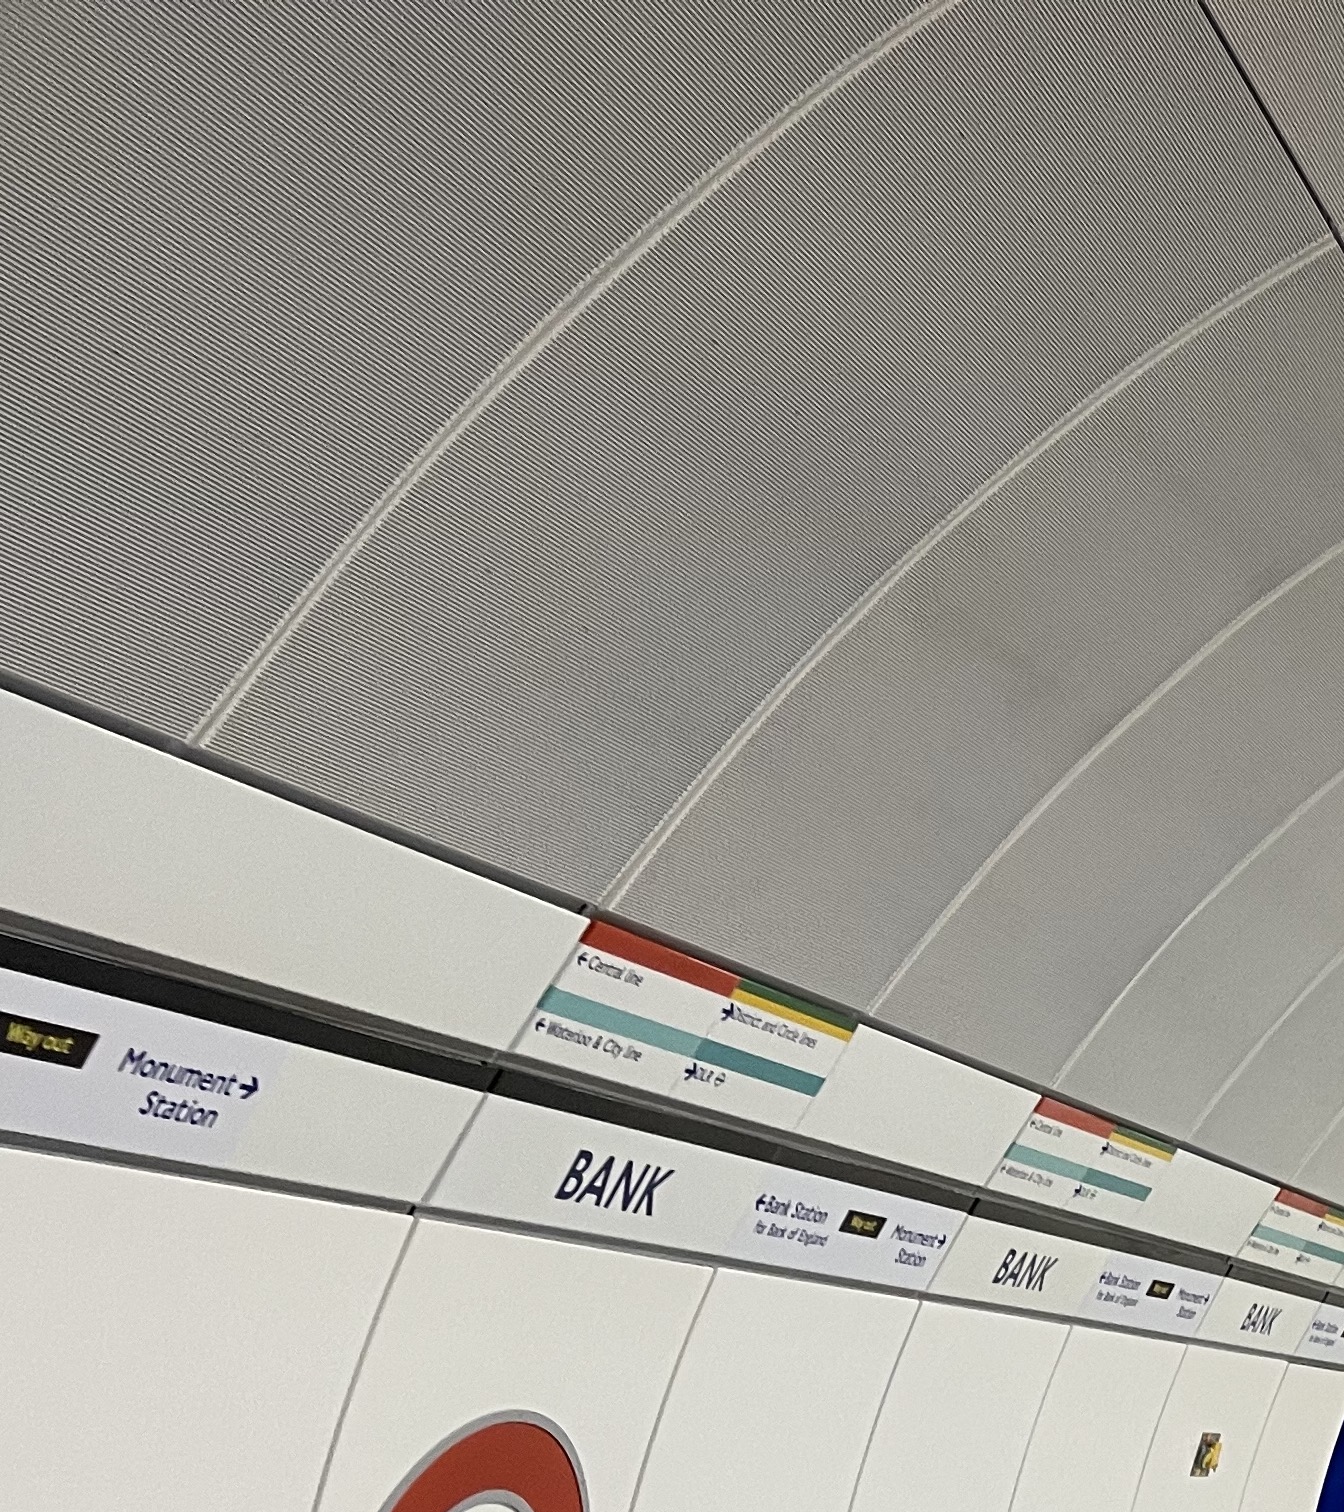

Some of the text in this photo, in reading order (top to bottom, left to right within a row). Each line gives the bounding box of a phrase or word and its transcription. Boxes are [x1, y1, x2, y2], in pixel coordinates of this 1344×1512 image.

[6, 1021, 75, 1055] Way out
[117, 1047, 238, 1097] Monument
[138, 1090, 219, 1128] Station
[555, 1149, 675, 1217] BANK
[764, 1195, 829, 1225] Bank Station
[890, 1223, 939, 1248] Monument
[895, 1247, 927, 1268] Station
[991, 1248, 1059, 1292] BANK
[1239, 1302, 1282, 1336] BANK
